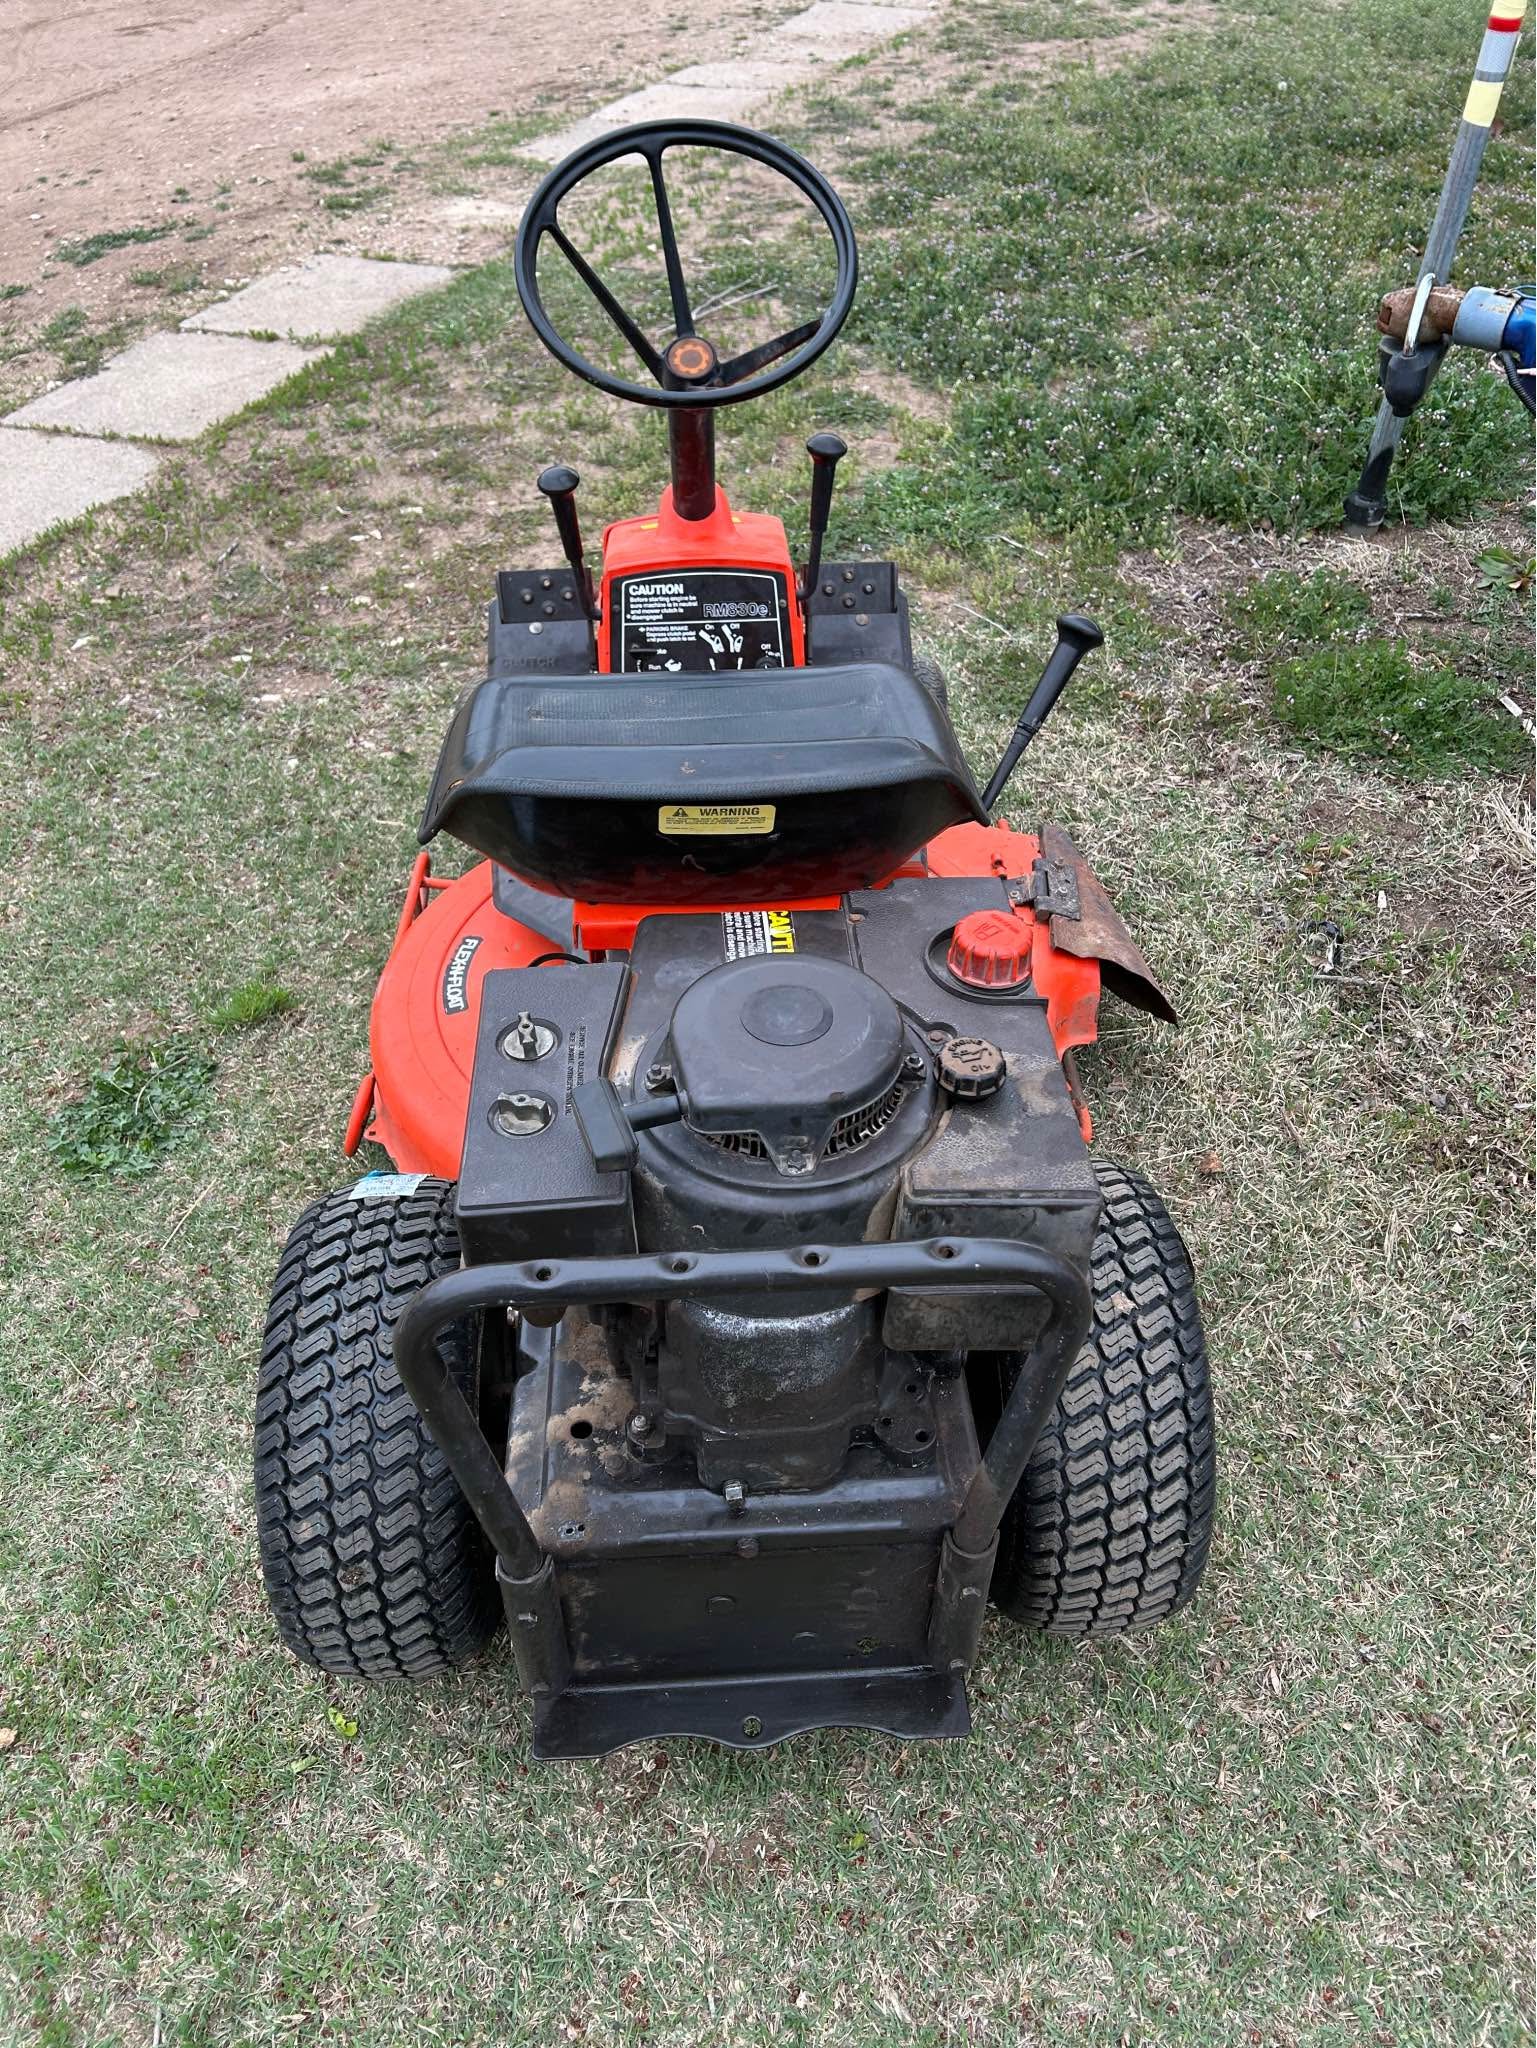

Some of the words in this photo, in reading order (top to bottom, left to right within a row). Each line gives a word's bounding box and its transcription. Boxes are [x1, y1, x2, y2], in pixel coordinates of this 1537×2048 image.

[629, 584, 684, 596] CAUTION
[703, 602, 768, 617] RM830e
[700, 807, 760, 816] WARNING
[736, 929, 746, 941] and
[768, 911, 794, 953] CAUTI
[746, 929, 756, 956] machin
[755, 928, 765, 953] starting
[738, 942, 746, 958] mow
[948, 1039, 983, 1052] ENGINE
